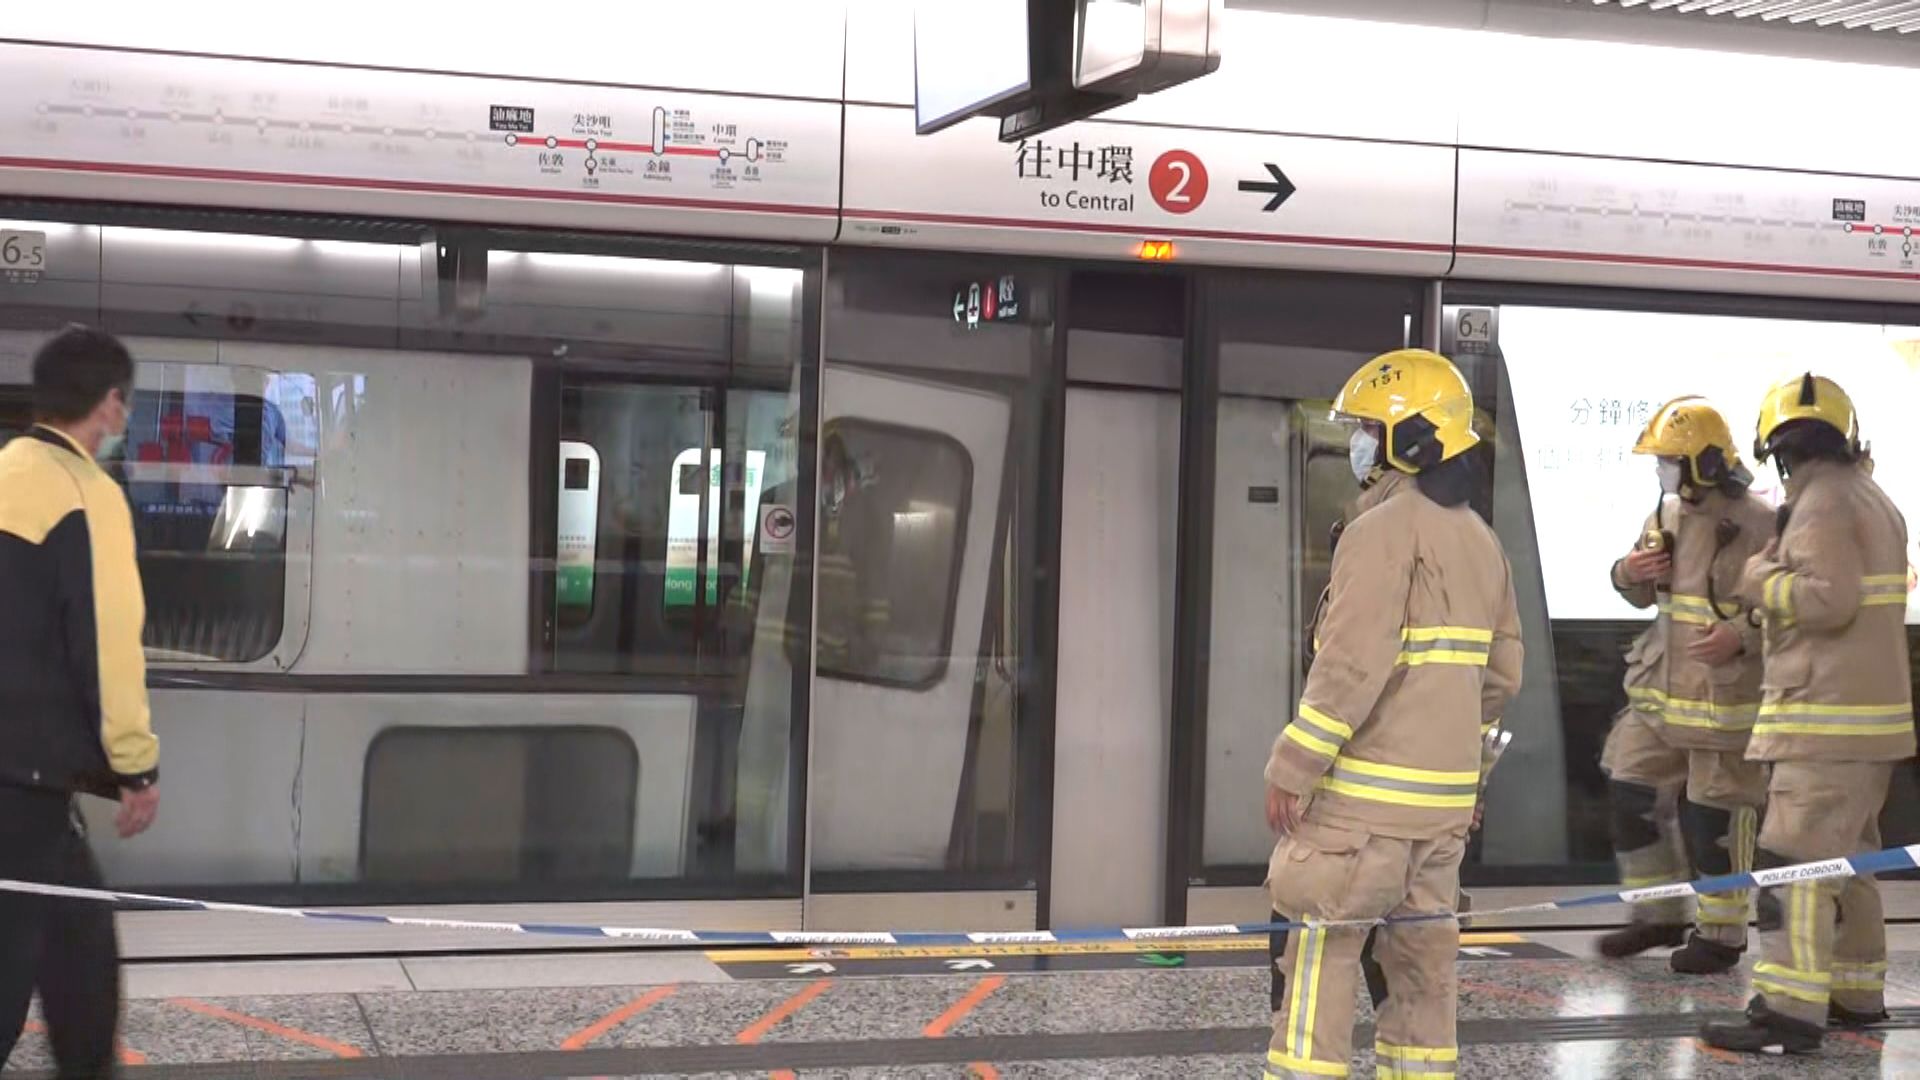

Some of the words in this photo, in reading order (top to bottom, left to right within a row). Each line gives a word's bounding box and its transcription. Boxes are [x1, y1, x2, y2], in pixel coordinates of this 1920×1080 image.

[1016, 140, 1134, 184] 往中環
[1165, 161, 1192, 203] 2
[1040, 191, 1060, 208] to
[1066, 190, 1134, 212] Central
[2, 235, 42, 265] 6-5
[1459, 312, 1488, 339] 6-4
[1370, 370, 1402, 388] TST
[1570, 398, 1662, 426] 分鐘修
[1762, 869, 1798, 881] POLICE
[1800, 863, 1842, 877] CORDON
